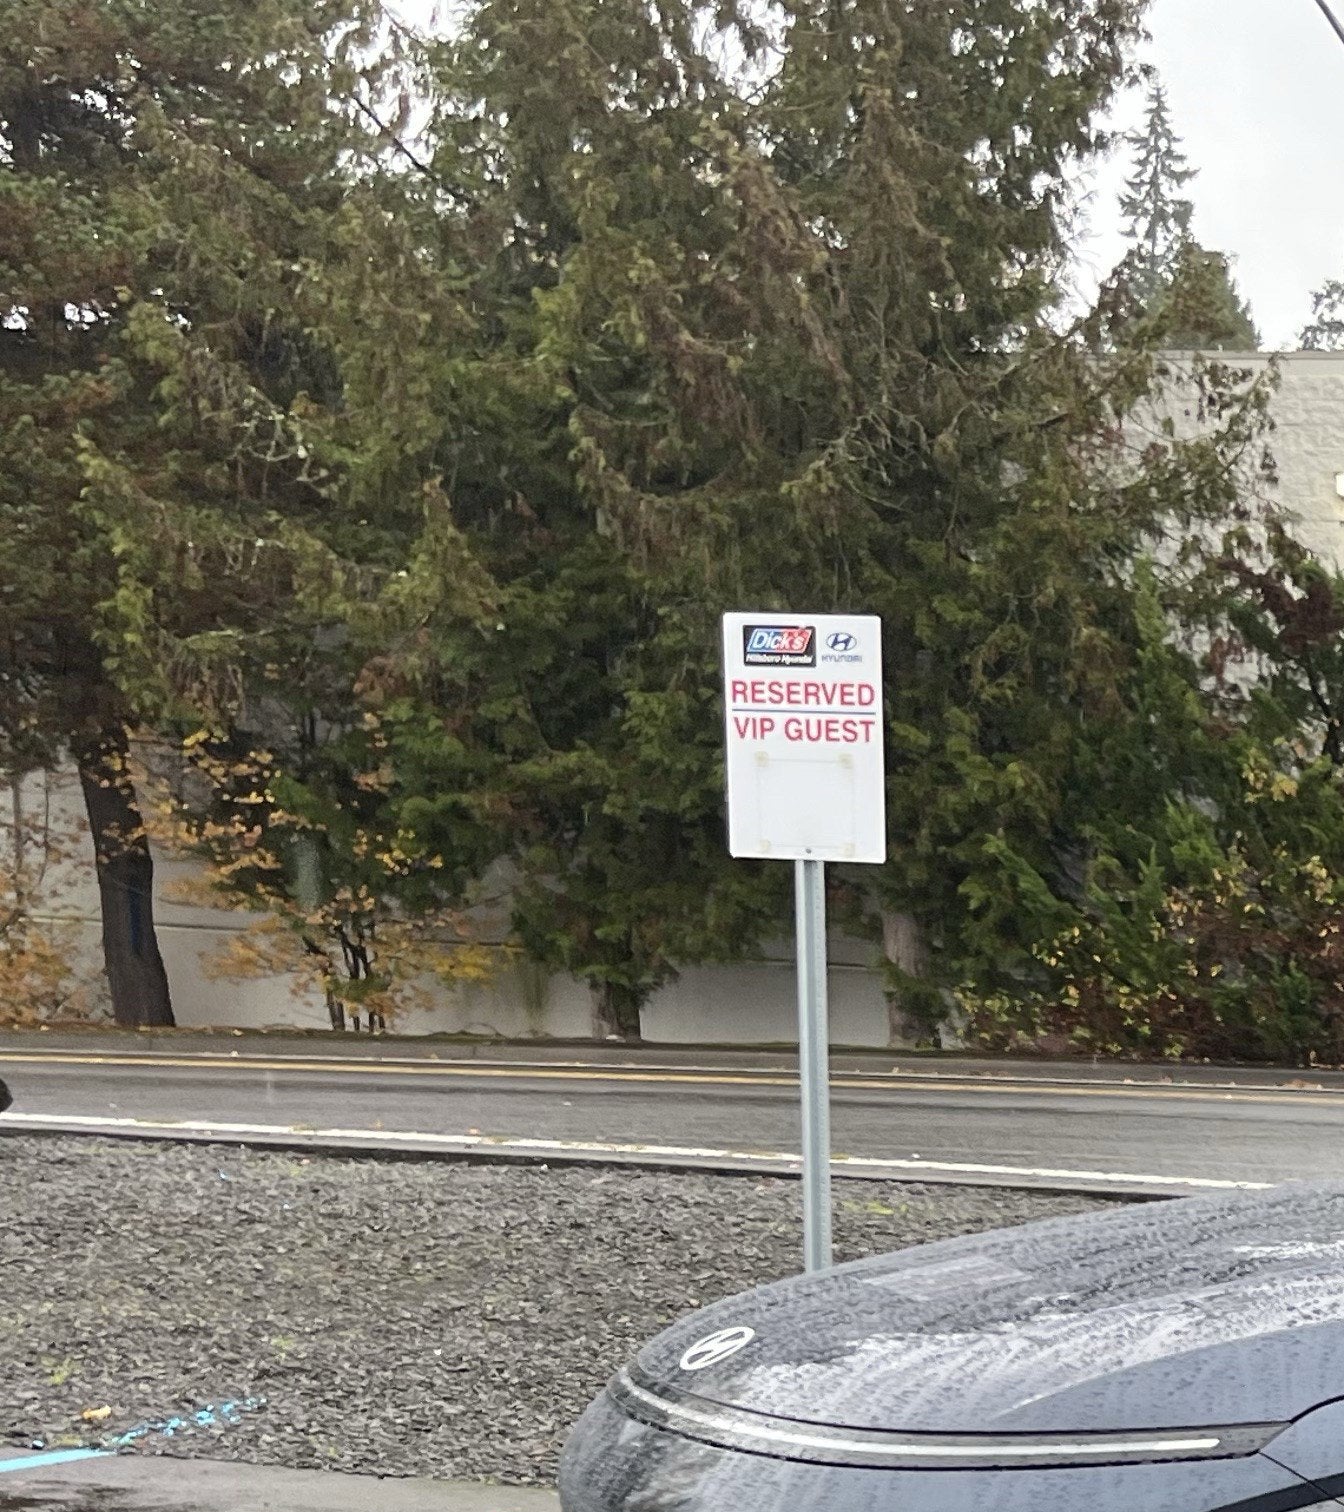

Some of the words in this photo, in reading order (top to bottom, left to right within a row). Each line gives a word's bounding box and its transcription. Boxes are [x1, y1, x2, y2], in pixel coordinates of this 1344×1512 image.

[732, 679, 876, 706] RESERVED
[733, 716, 775, 741] VIP
[784, 717, 876, 743] GUEST
